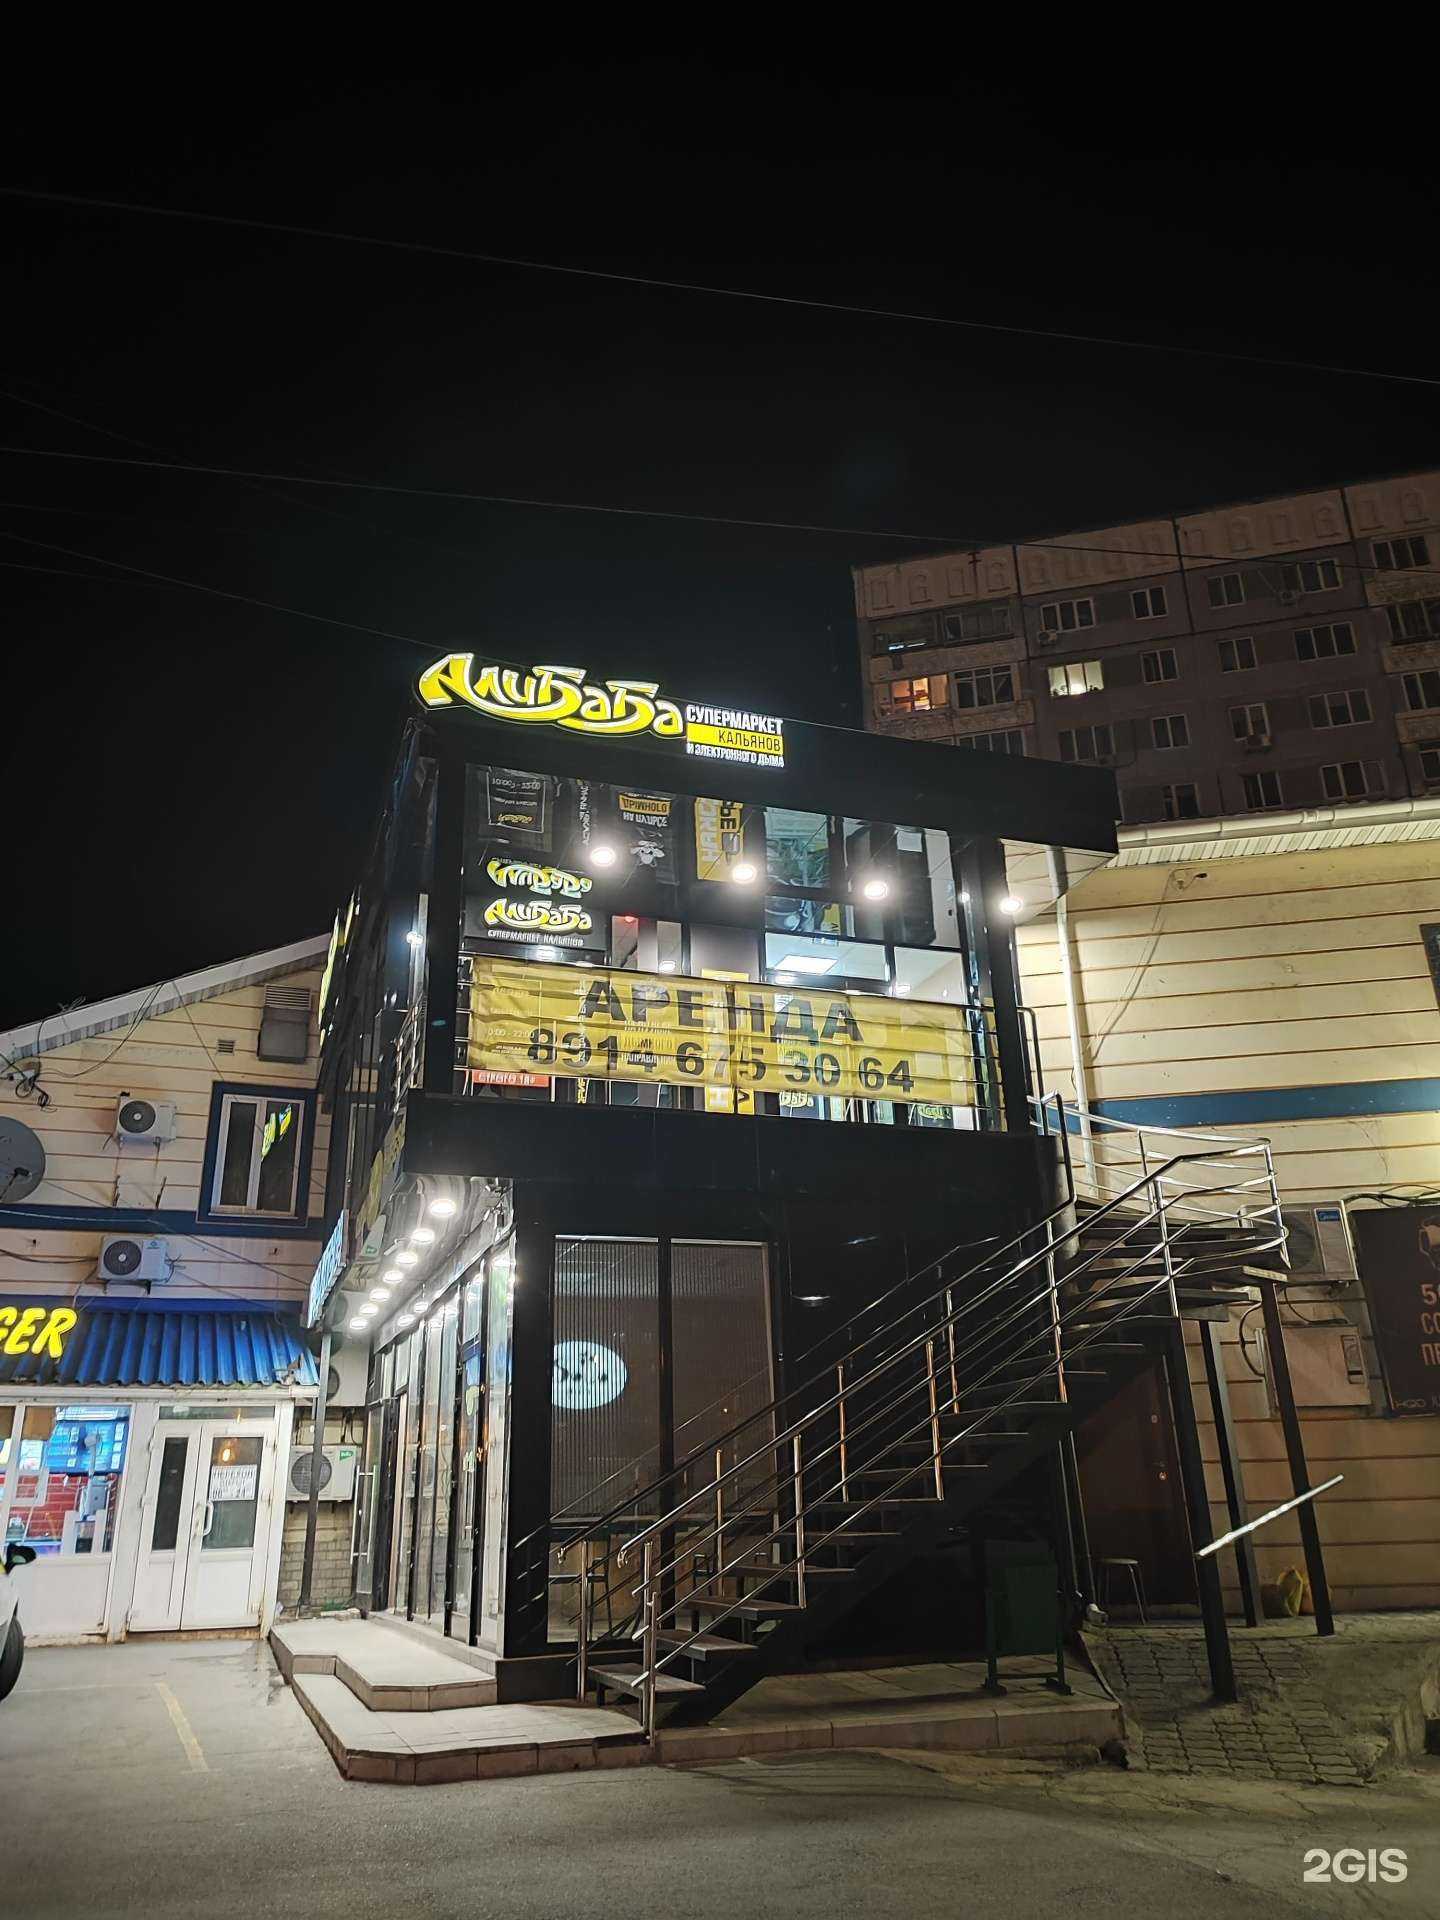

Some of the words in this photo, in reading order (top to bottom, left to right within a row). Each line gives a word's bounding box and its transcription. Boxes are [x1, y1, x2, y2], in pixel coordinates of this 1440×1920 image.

[686, 704, 783, 735] СУПЕРМАРКЕТ
[687, 742, 695, 754] И
[695, 743, 757, 764] ЭЛЕКТРОННОГО
[757, 753, 785, 768] ДЫМА
[718, 729, 781, 752] КАЛЬЯНОВ
[578, 979, 866, 1045] АРЕНДА
[527, 1028, 659, 1073] 8914
[676, 1041, 767, 1081] 675
[784, 1050, 841, 1088] 30
[858, 1057, 915, 1093] 64
